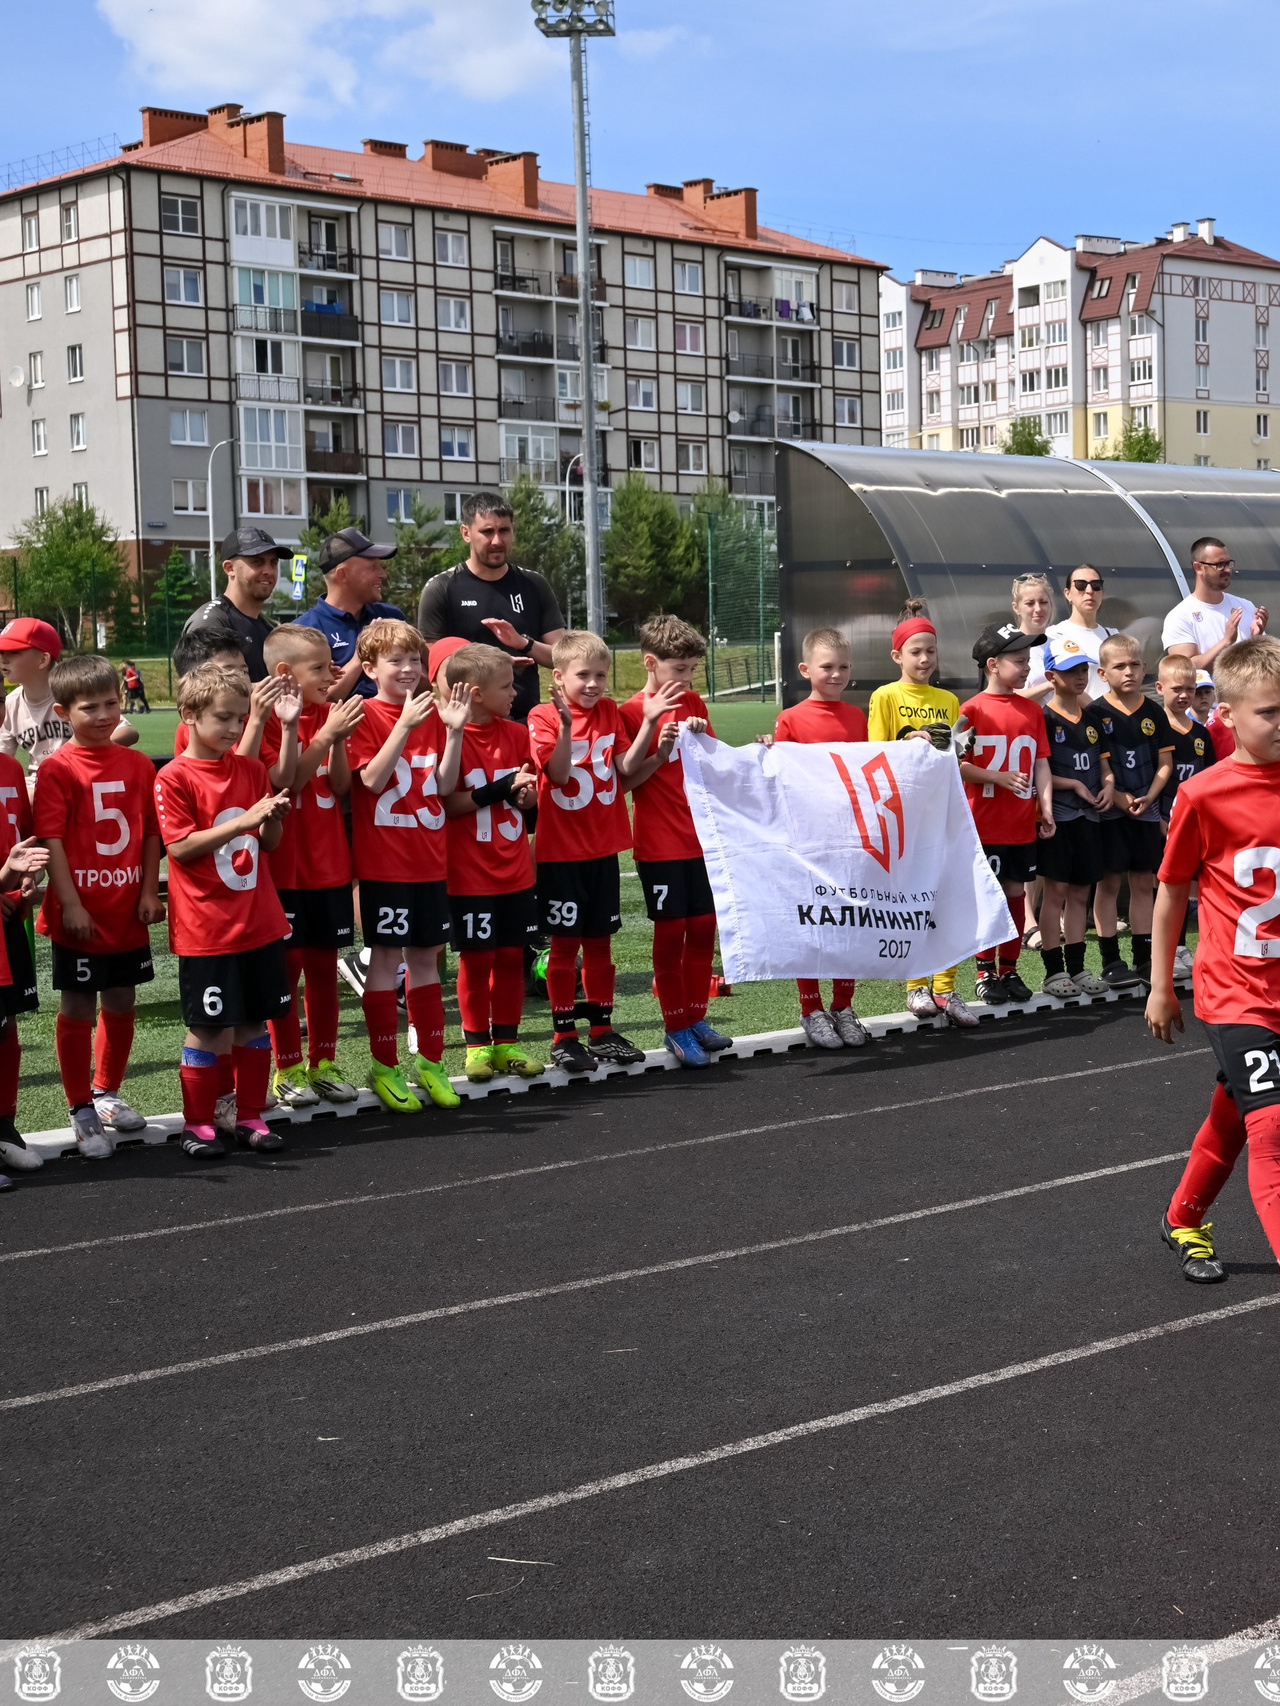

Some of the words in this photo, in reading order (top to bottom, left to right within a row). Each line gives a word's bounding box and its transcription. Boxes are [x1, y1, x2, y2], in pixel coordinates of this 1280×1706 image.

[997, 623, 1019, 640] FC
[899, 705, 949, 720] СОКОЛИК
[550, 732, 618, 811] 39
[974, 735, 1037, 799] 70
[1073, 753, 1090, 771] 10
[1126, 751, 1136, 769] 3
[1177, 764, 1195, 780] 77
[374, 753, 445, 830] 23
[92, 780, 131, 856] 5
[653, 885, 668, 910] 7
[377, 907, 409, 935] 23
[463, 913, 492, 939] 13
[547, 900, 578, 927] 39
[879, 939, 911, 958] 2017
[76, 958, 91, 981] 5
[203, 986, 223, 1016] 6
[664, 1008, 684, 1016] JAKO
